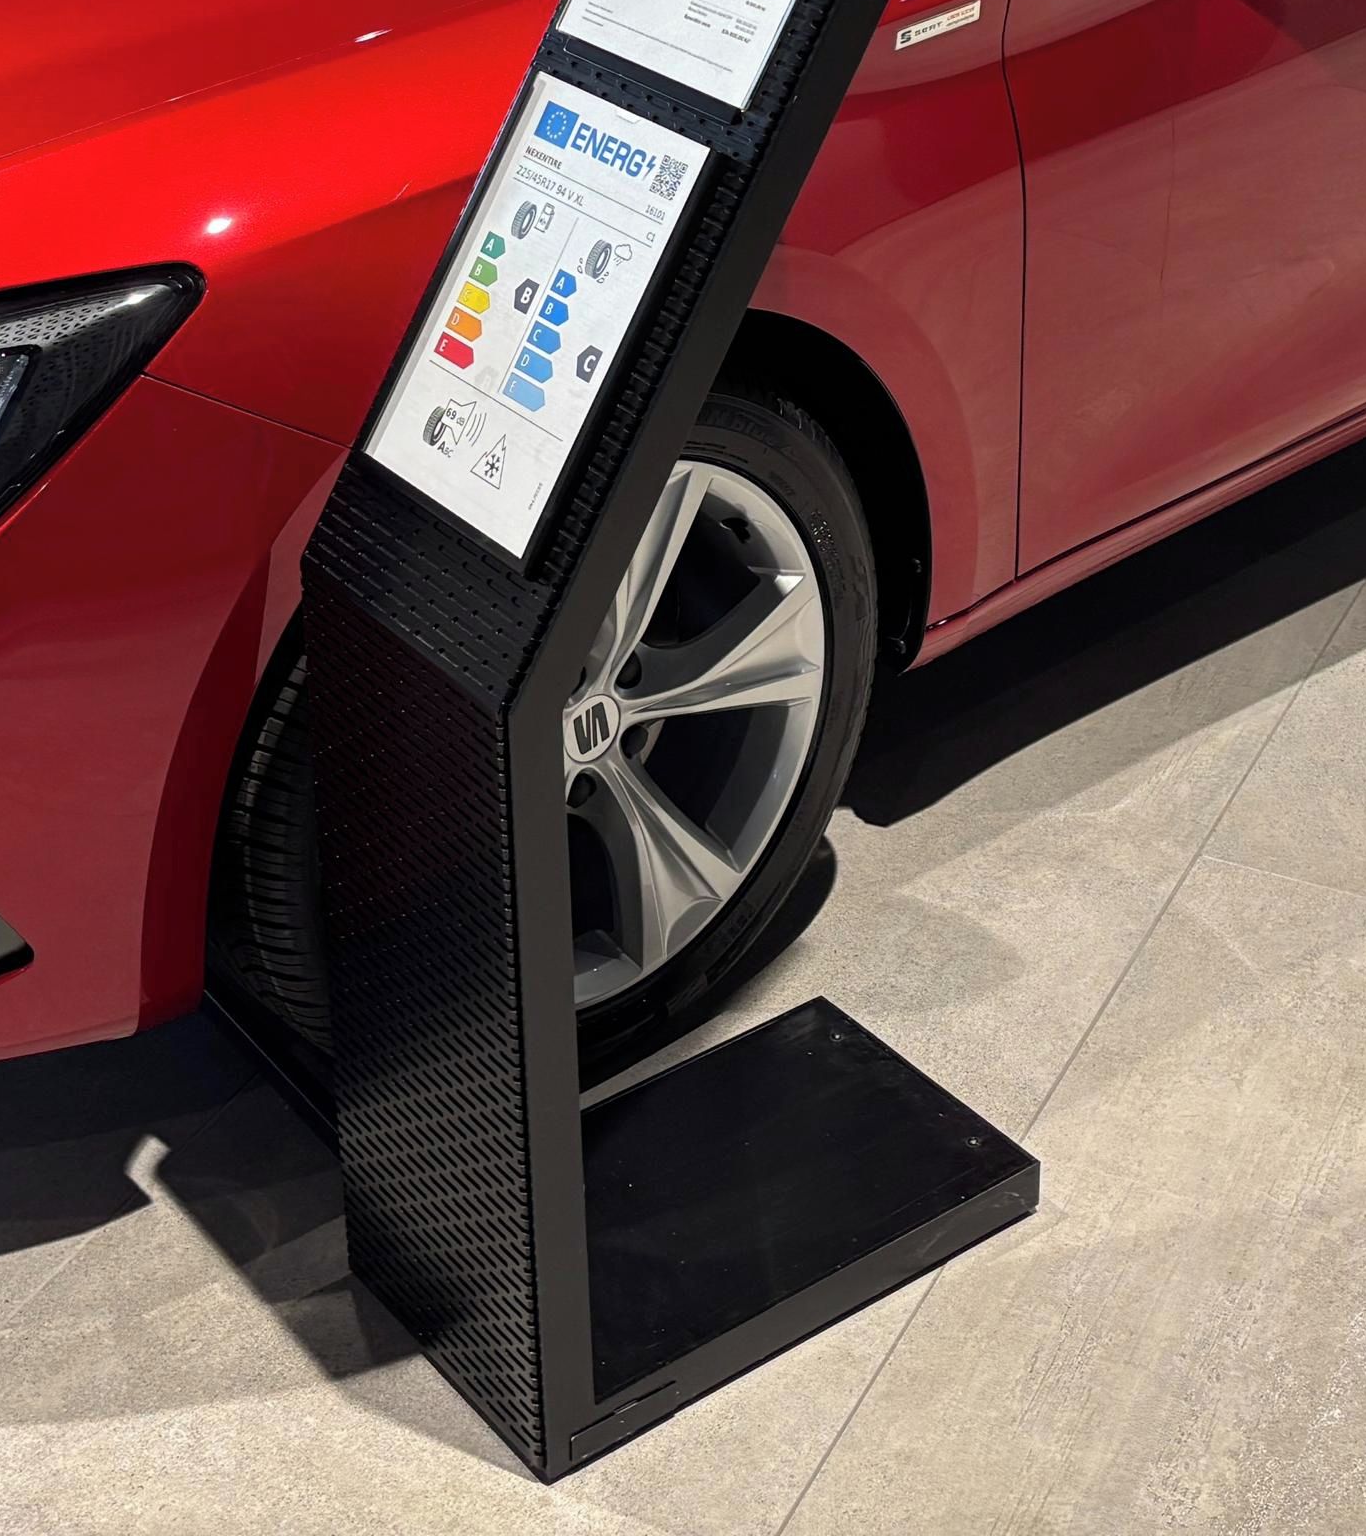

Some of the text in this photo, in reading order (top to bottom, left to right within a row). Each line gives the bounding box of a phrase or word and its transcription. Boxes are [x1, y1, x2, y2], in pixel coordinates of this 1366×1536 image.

[569, 122, 648, 178] ENERG
[525, 145, 563, 170] NEXENTIRE
[516, 164, 586, 206] 225/45R17 94 V XL
[485, 237, 495, 250] A
[474, 264, 482, 275] B
[556, 275, 566, 288] A
[521, 288, 533, 305] B
[544, 302, 553, 314] B
[451, 313, 460, 325] D
[532, 328, 541, 340] C
[439, 339, 447, 351] E
[520, 353, 530, 366] D
[582, 355, 596, 373] C
[446, 407, 457, 420] 69
